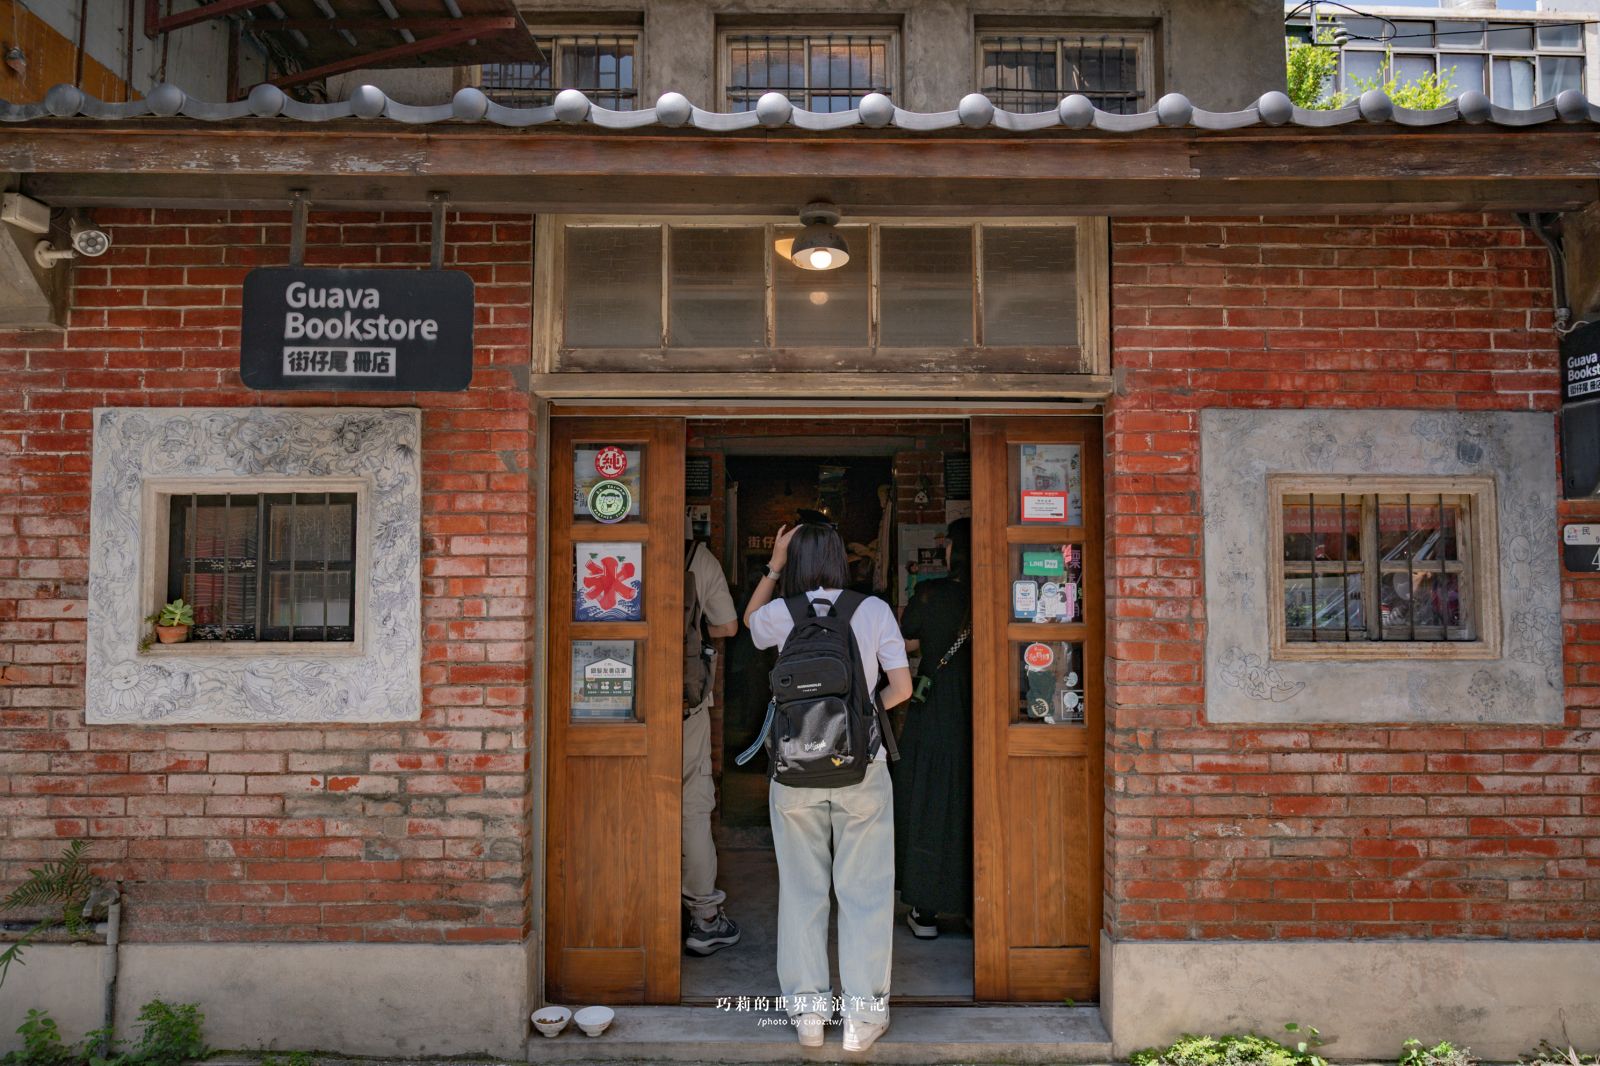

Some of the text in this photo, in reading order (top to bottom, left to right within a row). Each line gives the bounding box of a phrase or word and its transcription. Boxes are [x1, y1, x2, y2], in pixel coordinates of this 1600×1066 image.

[285, 281, 380, 309] Guava
[284, 310, 439, 341] Bookstore
[287, 350, 348, 373] 街仔尾
[1568, 353, 1597, 368] Guava
[1583, 527, 1590, 535] 民
[1029, 560, 1058, 569] LINE Pay
